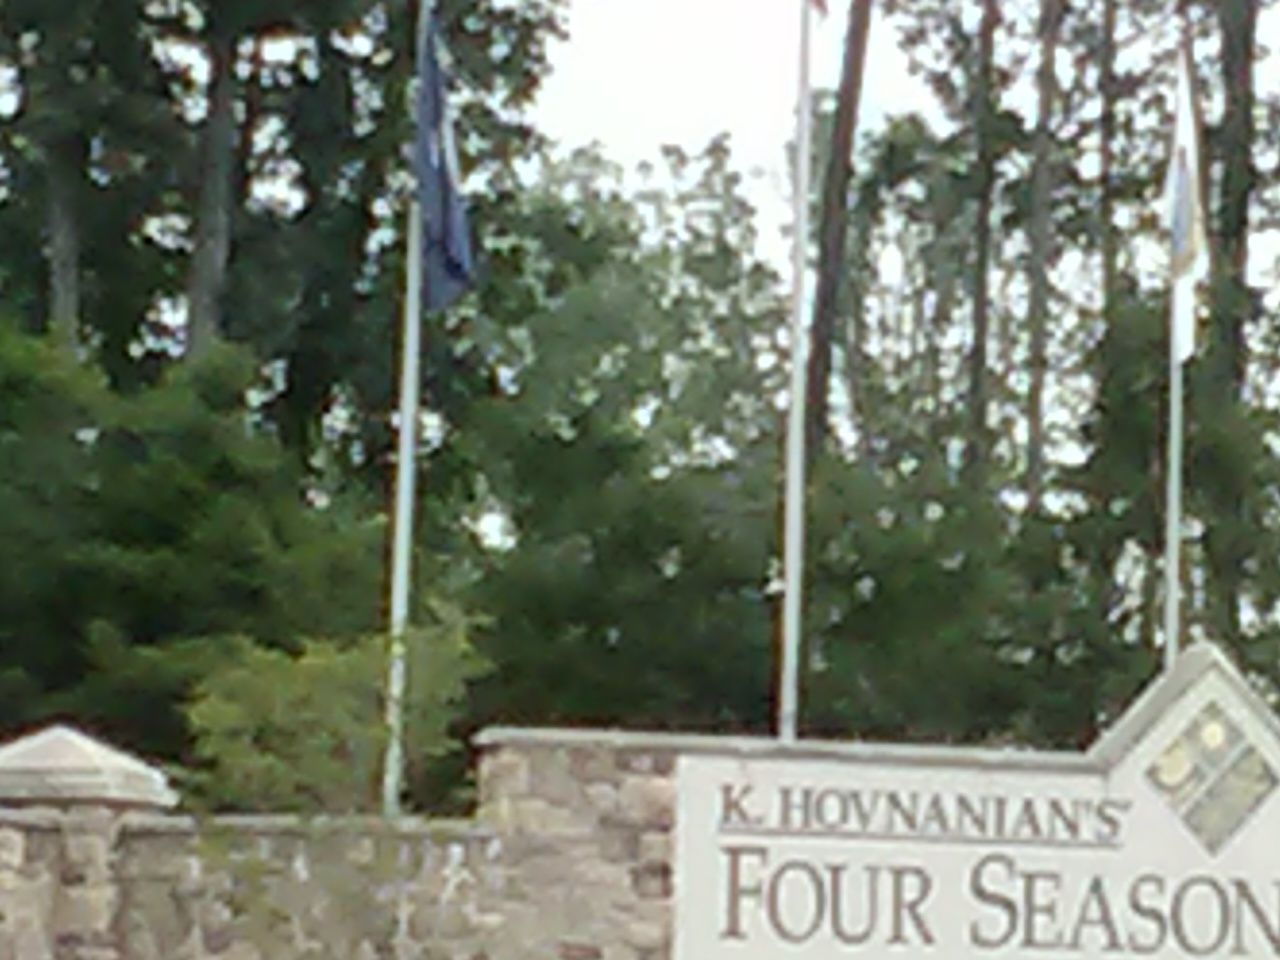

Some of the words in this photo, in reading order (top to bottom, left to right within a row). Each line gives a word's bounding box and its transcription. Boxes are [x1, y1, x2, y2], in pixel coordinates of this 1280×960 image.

[721, 783, 765, 826] K.
[778, 786, 1125, 840] HOVNANIAN'S
[719, 845, 936, 945] FOUR
